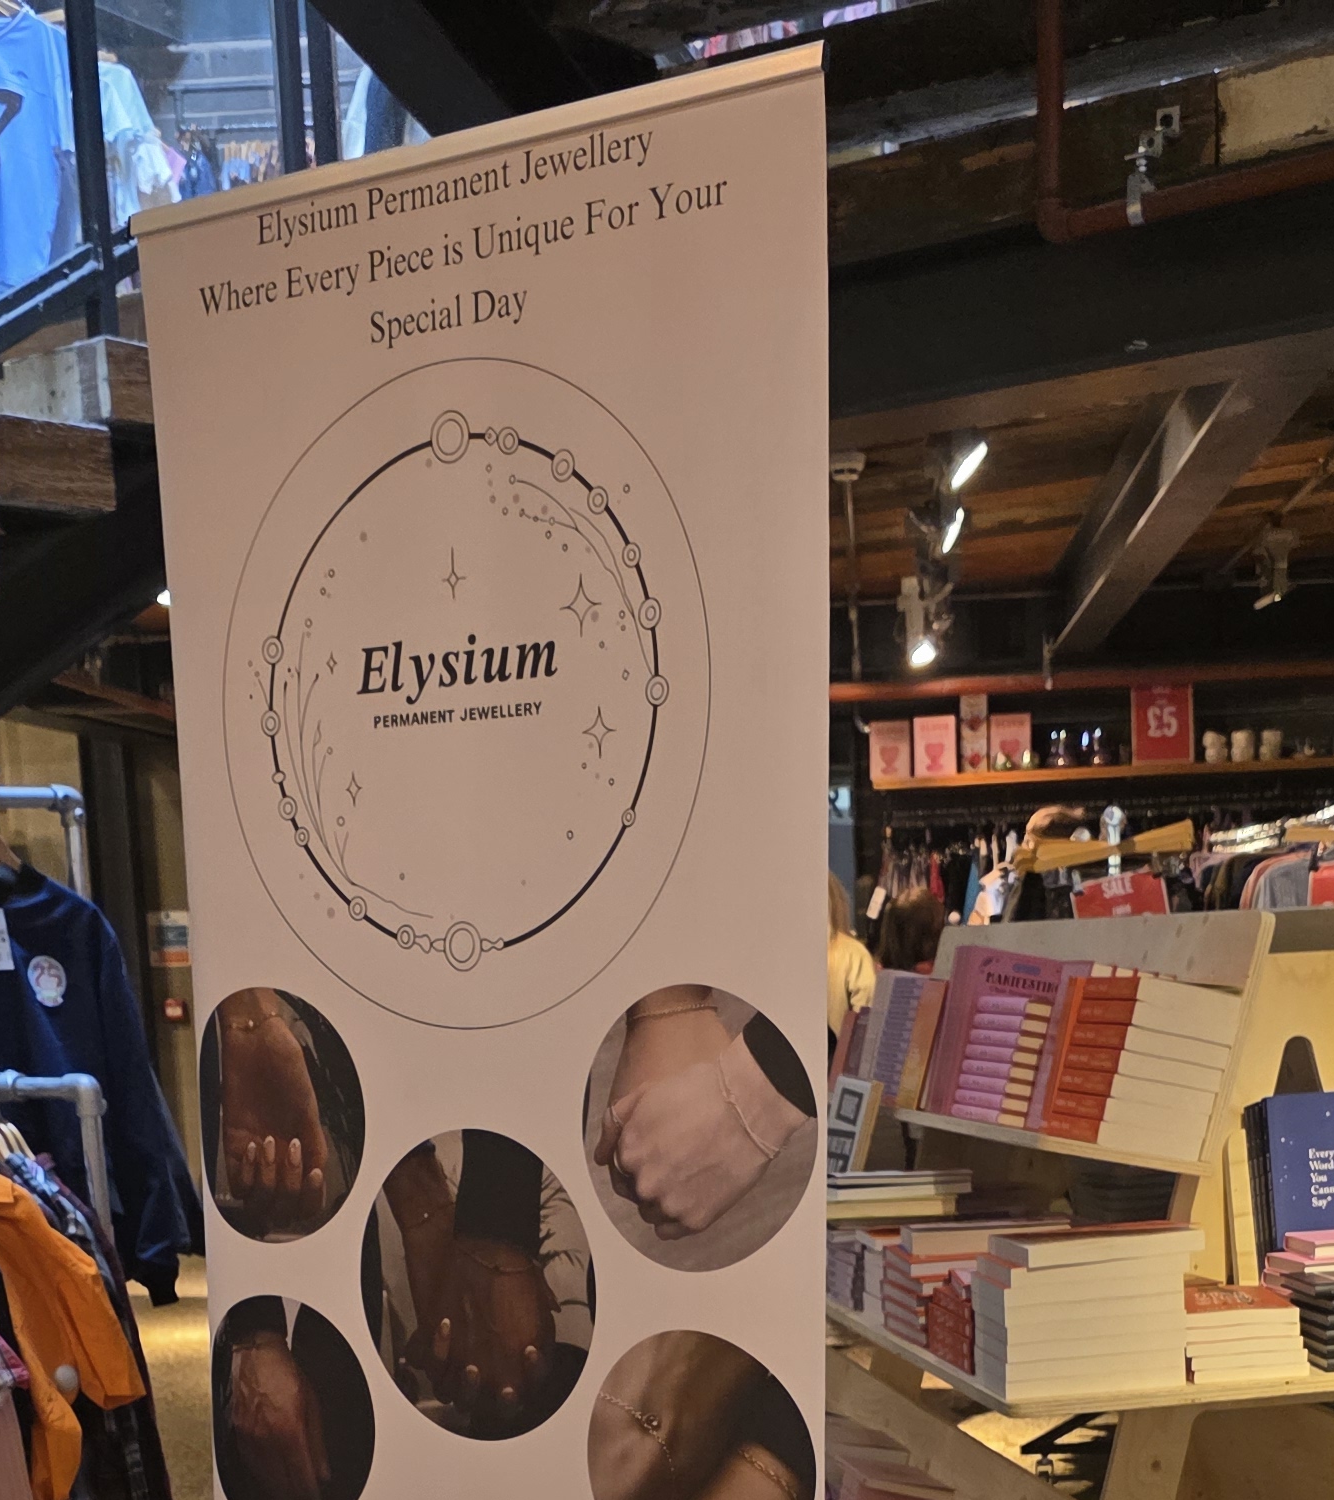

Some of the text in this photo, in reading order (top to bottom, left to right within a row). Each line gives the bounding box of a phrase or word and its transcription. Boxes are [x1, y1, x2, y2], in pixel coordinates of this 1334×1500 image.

[256, 127, 655, 248] Elysium Permanent Jewellery
[198, 177, 729, 317] Where Every Piece is Unique For Your
[369, 285, 530, 351] Special Day
[356, 633, 558, 705] Elysium
[373, 701, 542, 729] PERMANENT JEWELLERY
[1147, 705, 1179, 738] £5
[1100, 875, 1134, 898] SALE
[1308, 1148, 1334, 1160] Every
[1309, 1160, 1334, 1171] Word
[1310, 1172, 1327, 1183] You
